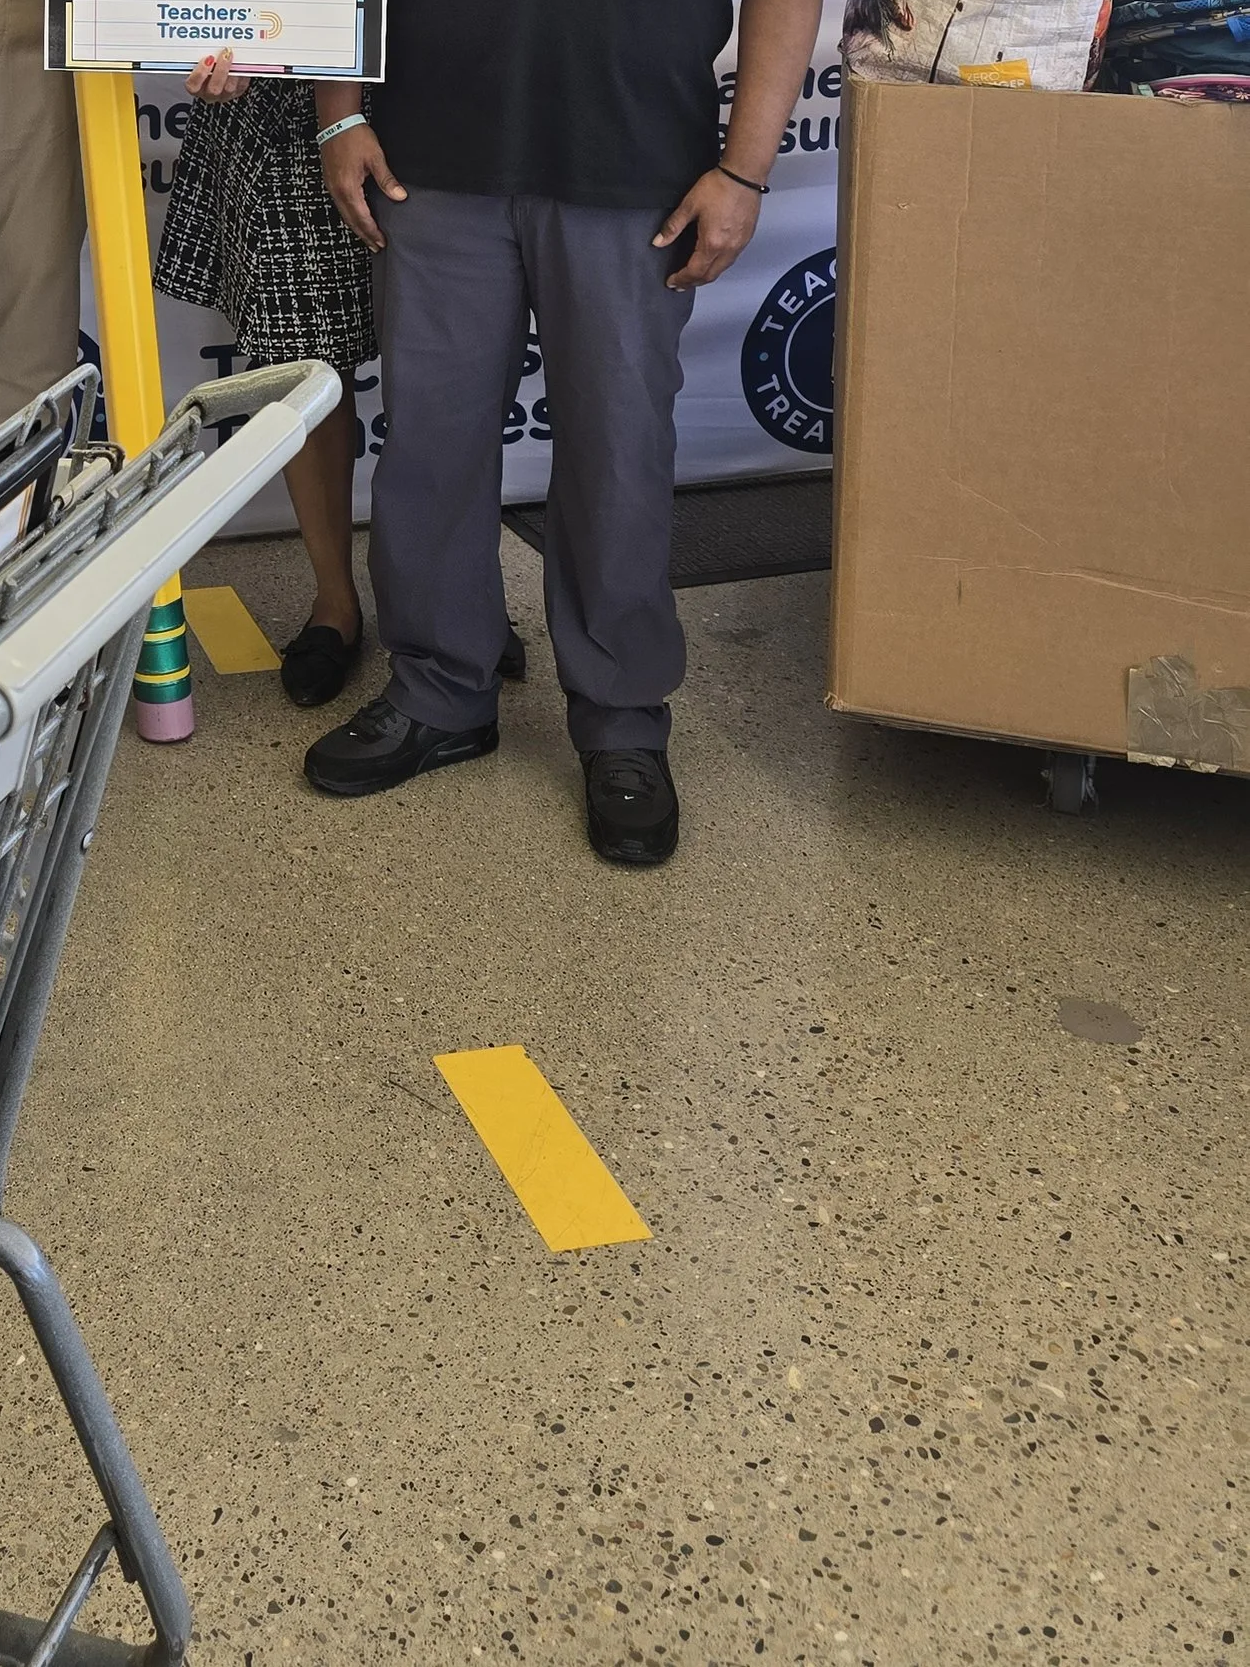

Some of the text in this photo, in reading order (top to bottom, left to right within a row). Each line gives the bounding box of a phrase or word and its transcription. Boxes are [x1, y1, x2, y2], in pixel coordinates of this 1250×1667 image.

[157, 3, 251, 21] Teachers'
[157, 22, 254, 40] Treasures
[967, 71, 1000, 82] ZERO
